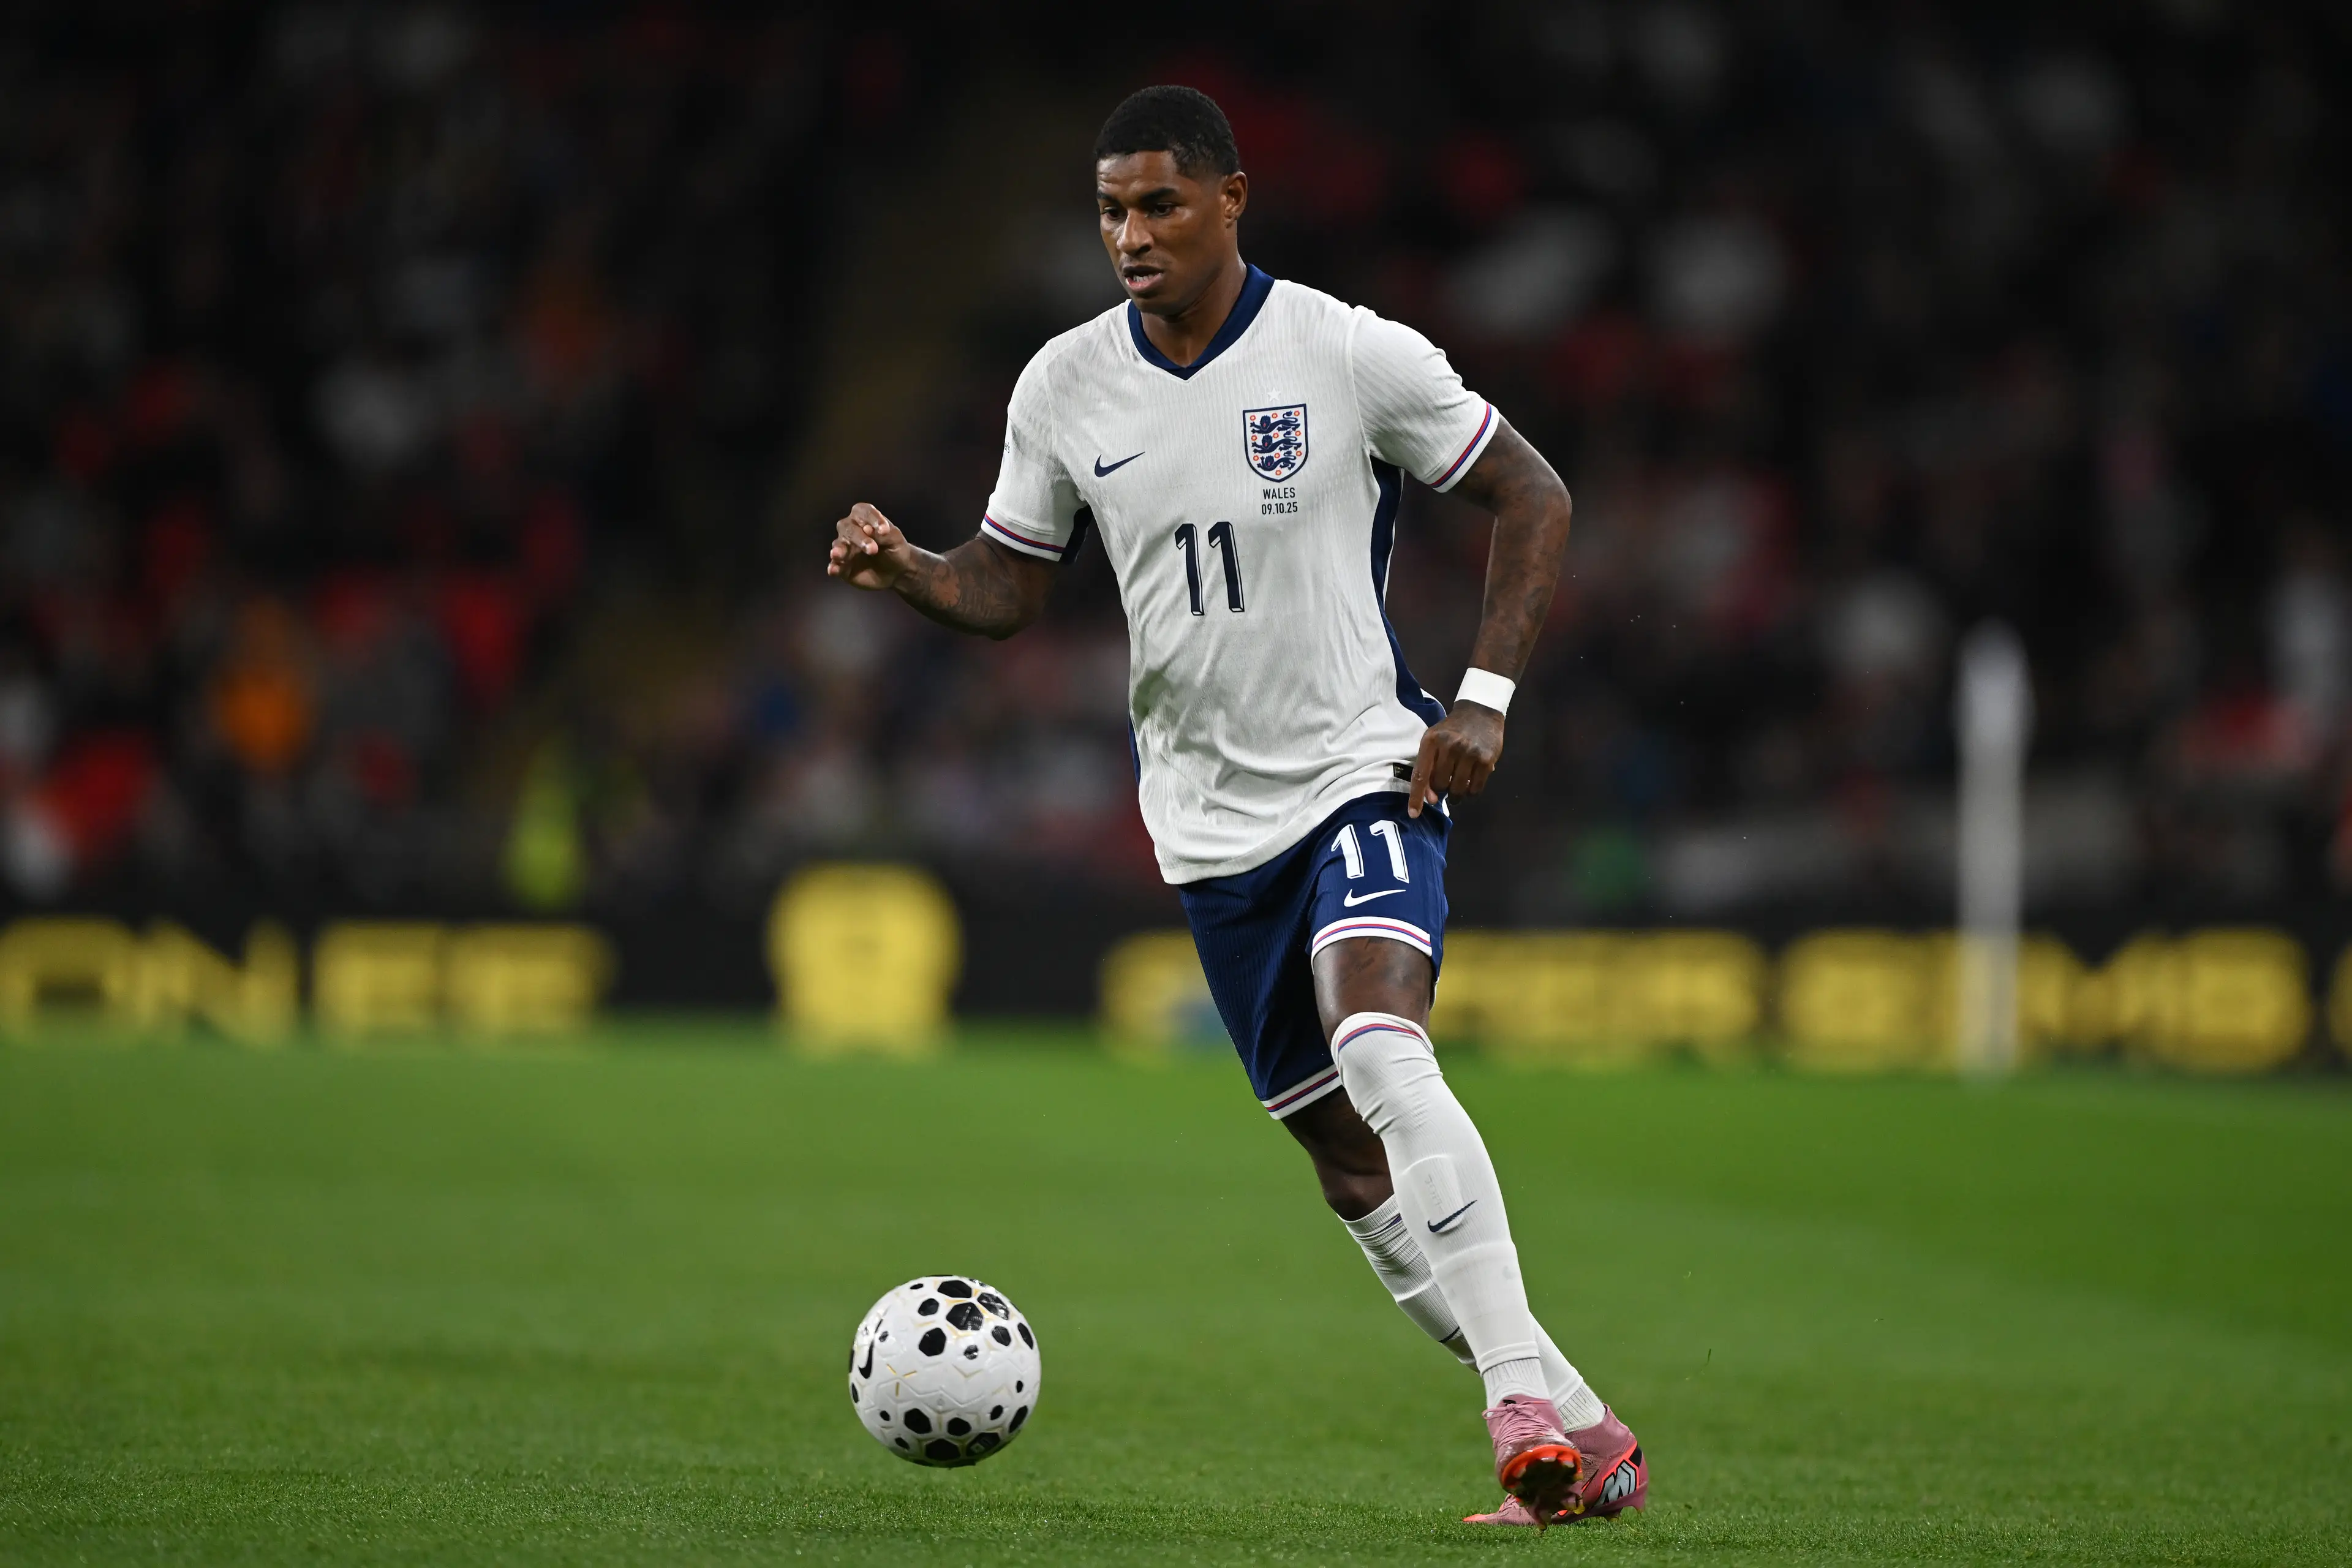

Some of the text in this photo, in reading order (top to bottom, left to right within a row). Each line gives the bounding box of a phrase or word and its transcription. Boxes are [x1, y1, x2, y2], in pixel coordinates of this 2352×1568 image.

[1262, 487, 1295, 500] WALES
[1262, 502, 1298, 515] 09.10.25
[1174, 521, 1245, 616] 11
[1331, 820, 1409, 883] 11
